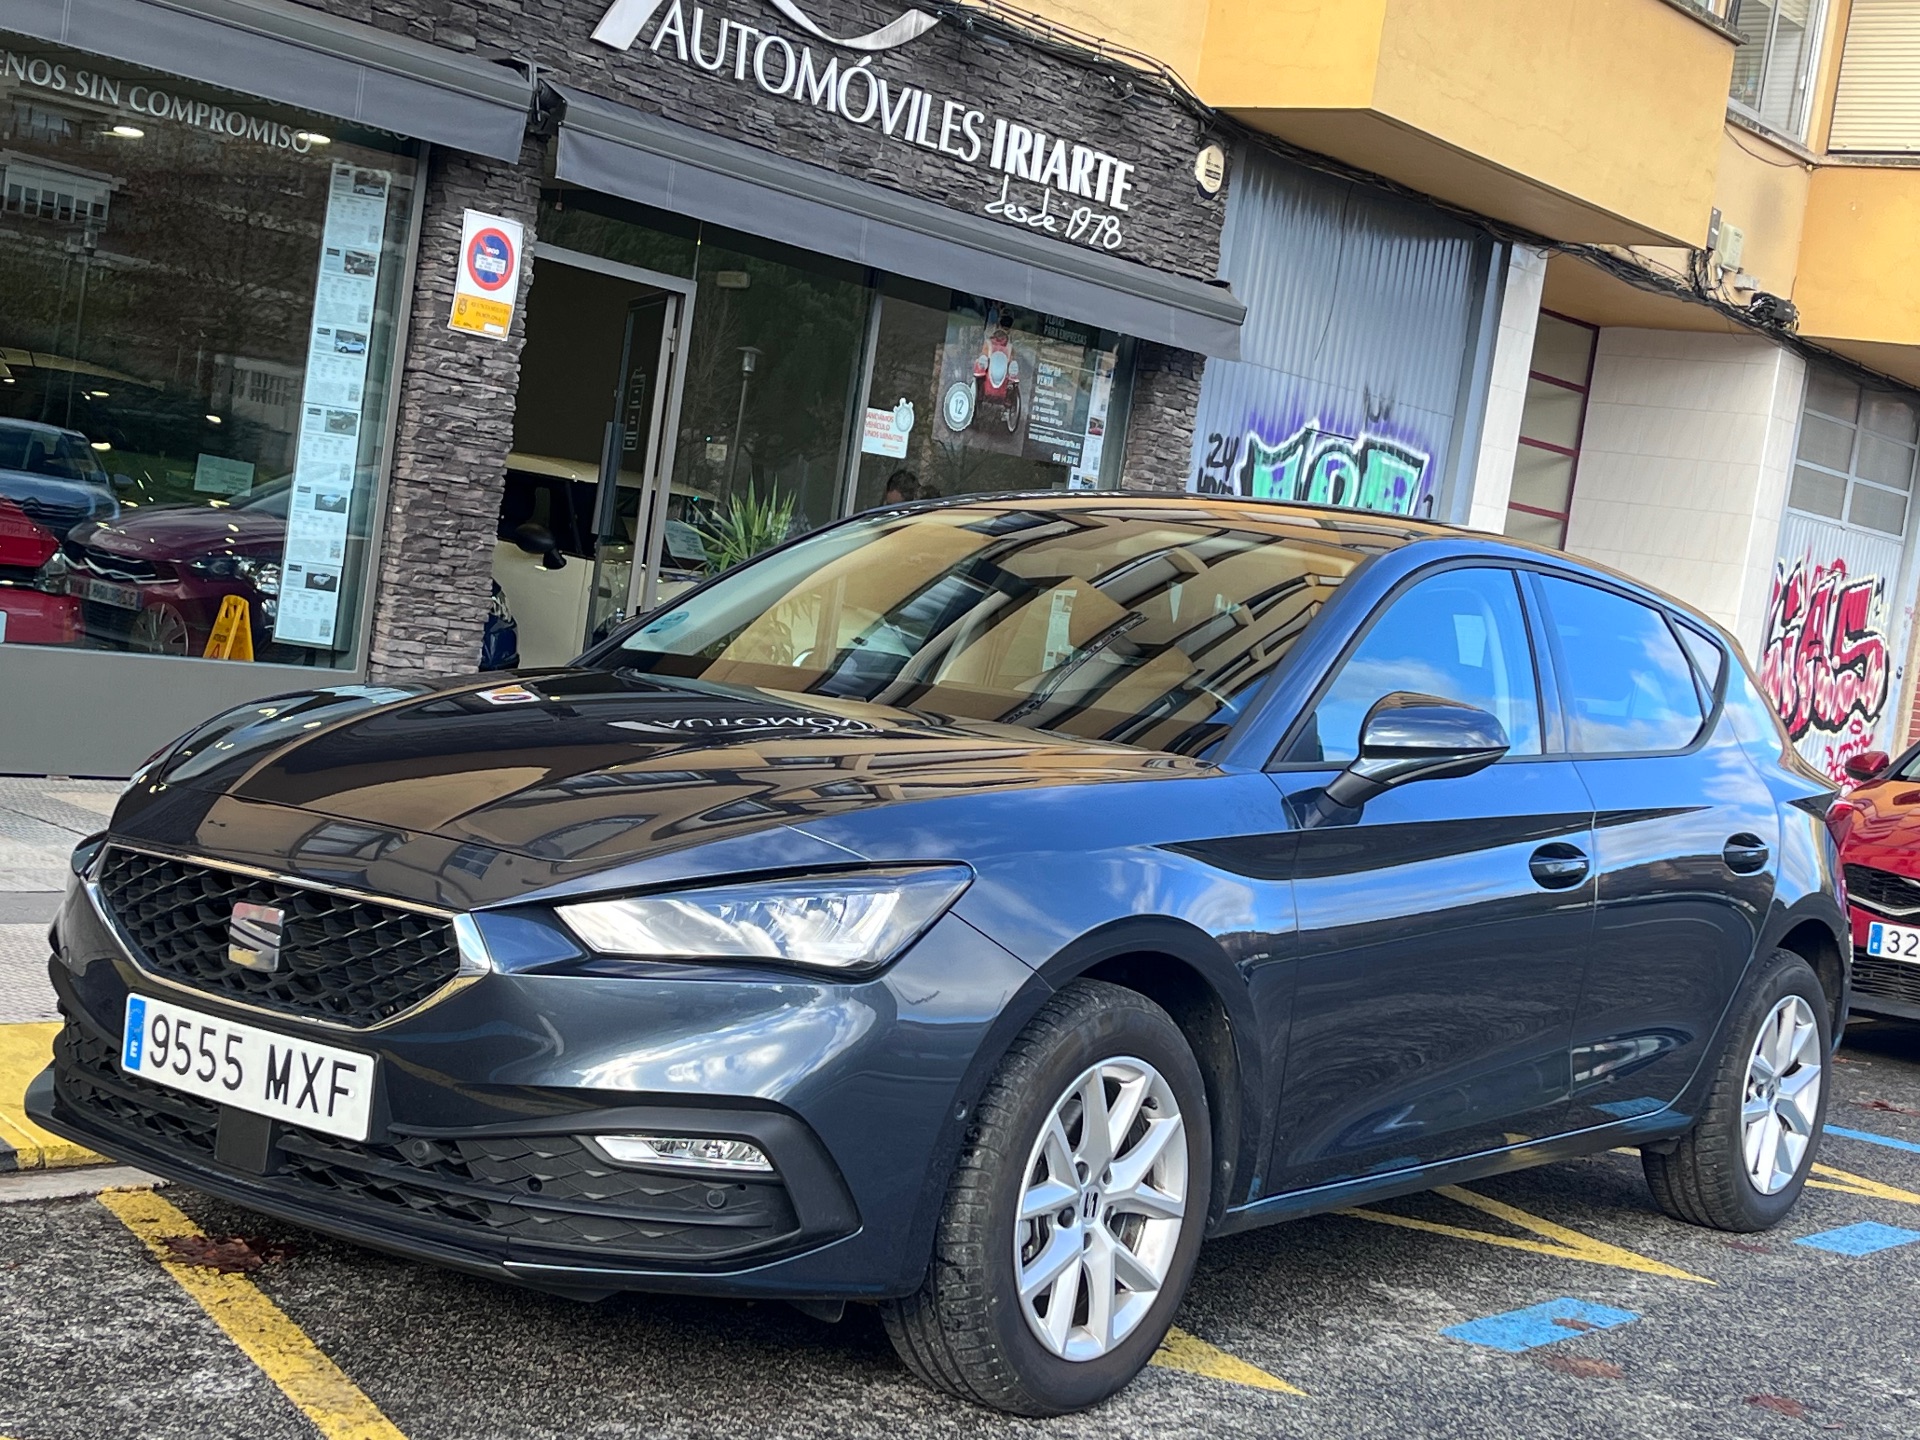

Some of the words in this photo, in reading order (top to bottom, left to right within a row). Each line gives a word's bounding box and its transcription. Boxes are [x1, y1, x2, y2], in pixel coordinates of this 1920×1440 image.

[0, 51, 67, 91] NOS
[74, 70, 121, 105] SIN
[129, 85, 312, 153] COMPROMISO
[649, 0, 984, 162] AUTOMÓVILES
[990, 119, 1134, 211] IRIARTE
[984, 174, 1057, 232] desde
[1065, 207, 1122, 249] 1978
[955, 398, 964, 414] 12
[1886, 929, 1919, 957] 32
[129, 1041, 138, 1058] E
[150, 1013, 243, 1091] 9555
[264, 1043, 357, 1117] MXF
